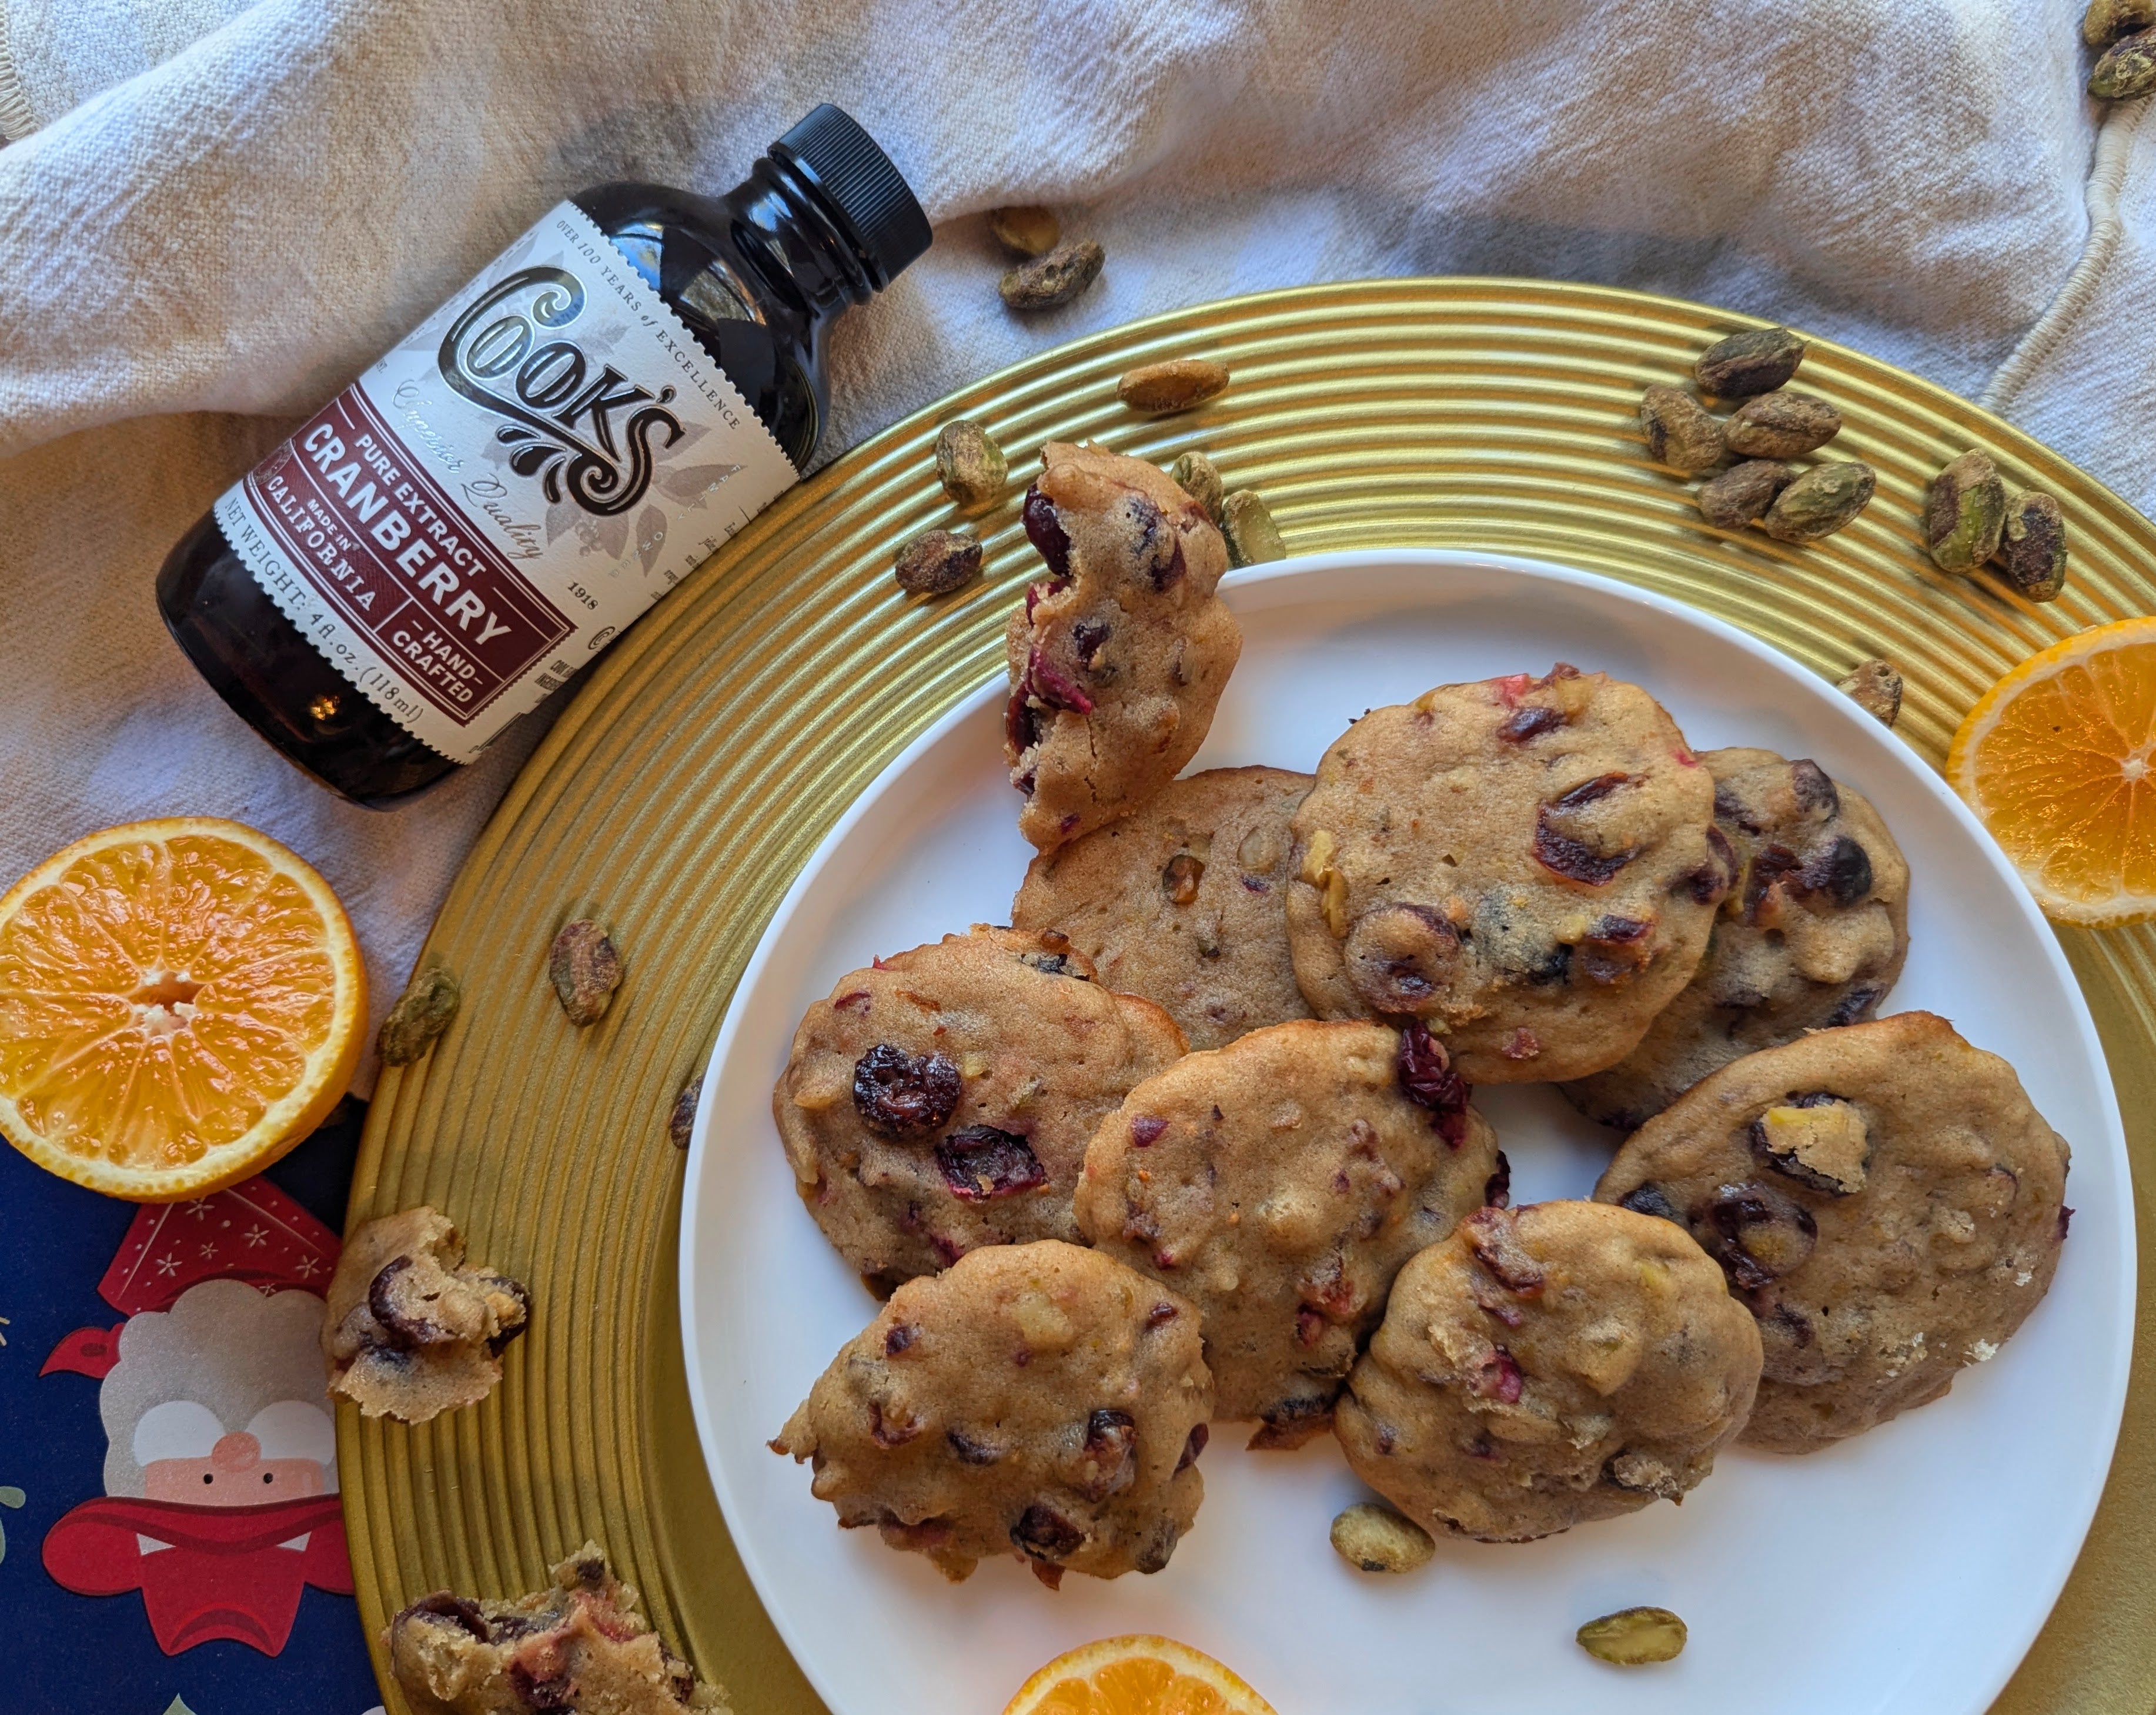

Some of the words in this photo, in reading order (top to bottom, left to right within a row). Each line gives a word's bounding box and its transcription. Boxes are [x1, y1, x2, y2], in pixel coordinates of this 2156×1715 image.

[556, 220, 580, 244] OVER
[578, 243, 600, 265] 100
[600, 266, 642, 312] YEARS
[641, 315, 659, 328] of
[656, 327, 740, 430] EXCELLENCE
[224, 497, 246, 526] NET
[240, 524, 306, 611] WEIGHT:
[268, 475, 376, 611] CALIFORNIA
[304, 423, 512, 646] CRANBERRY
[307, 499, 338, 534] MADE
[335, 533, 352, 551] IN
[356, 433, 400, 486] PURE
[395, 482, 487, 576] EXTRACT
[461, 473, 543, 559] Quality
[568, 581, 599, 610] 1918
[393, 630, 473, 703] CRAFTED
